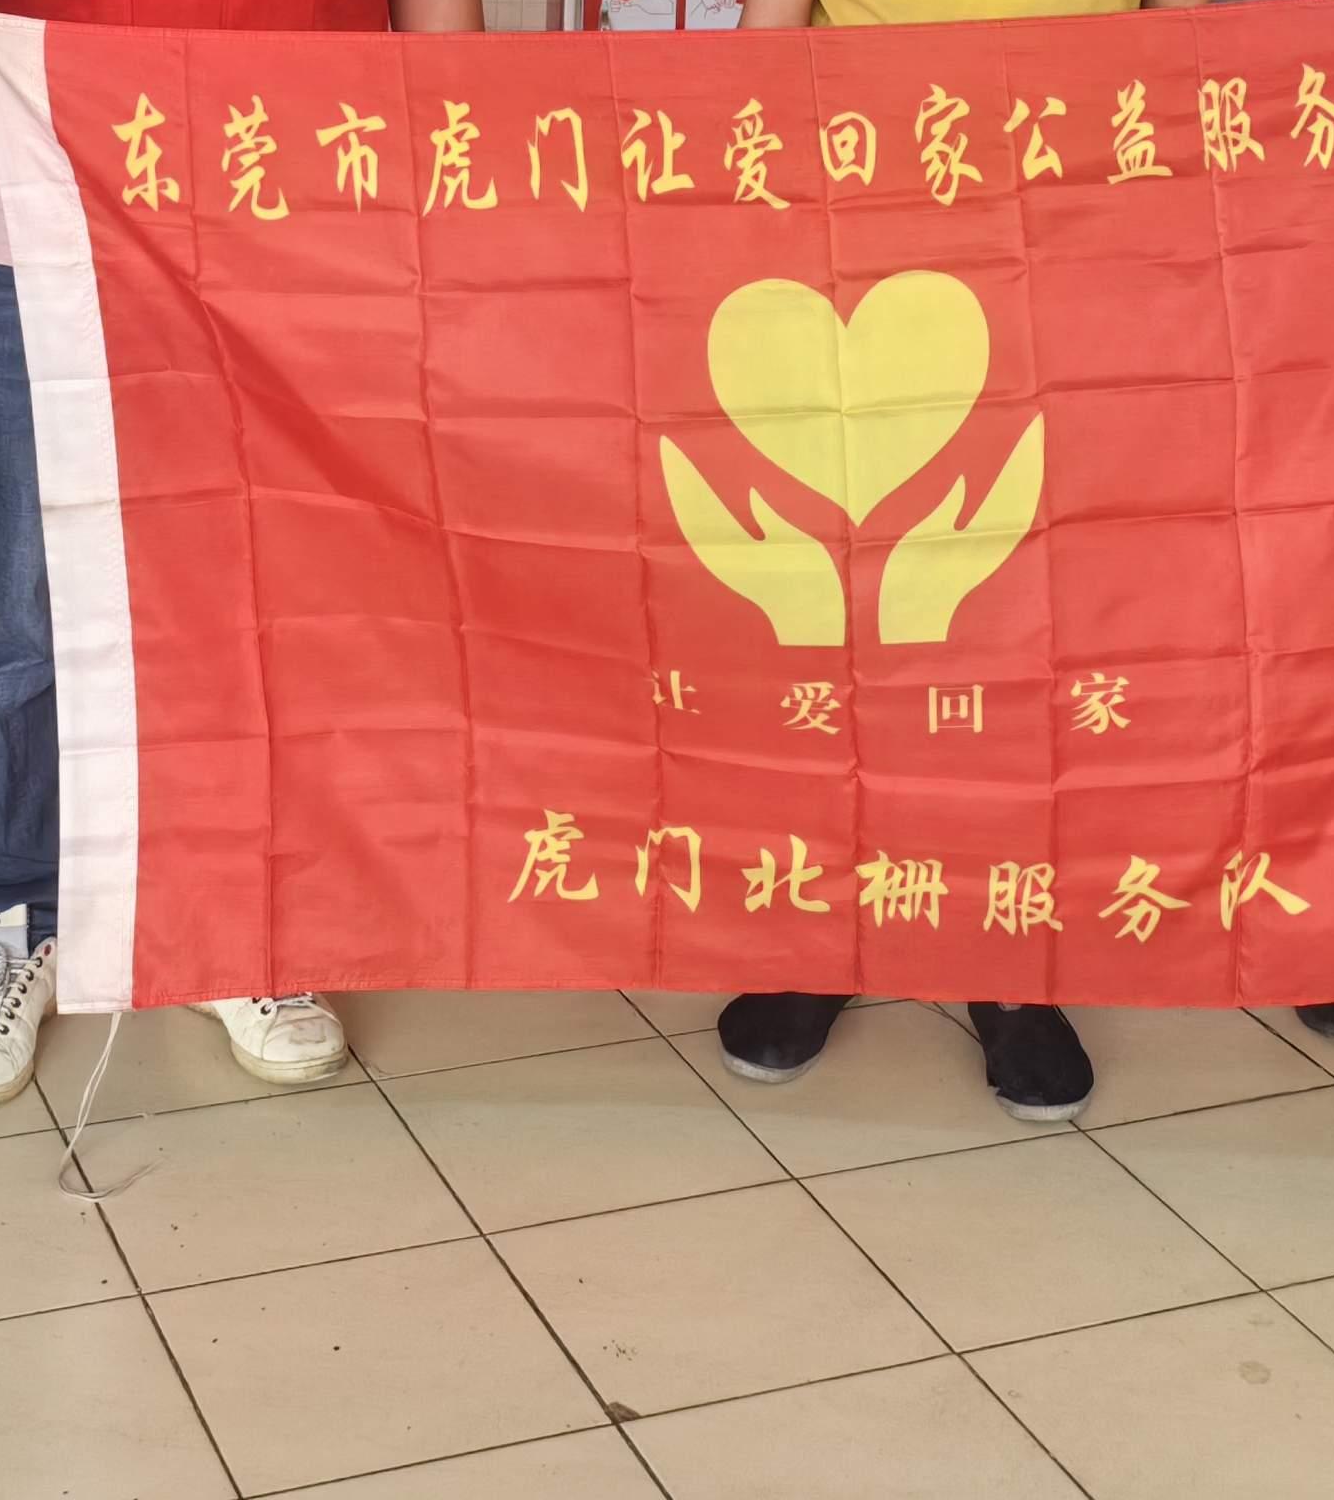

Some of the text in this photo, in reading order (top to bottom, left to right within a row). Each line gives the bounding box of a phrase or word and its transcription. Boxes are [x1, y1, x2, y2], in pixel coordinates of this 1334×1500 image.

[507, 810, 1311, 944] 虎门北栅服务队
